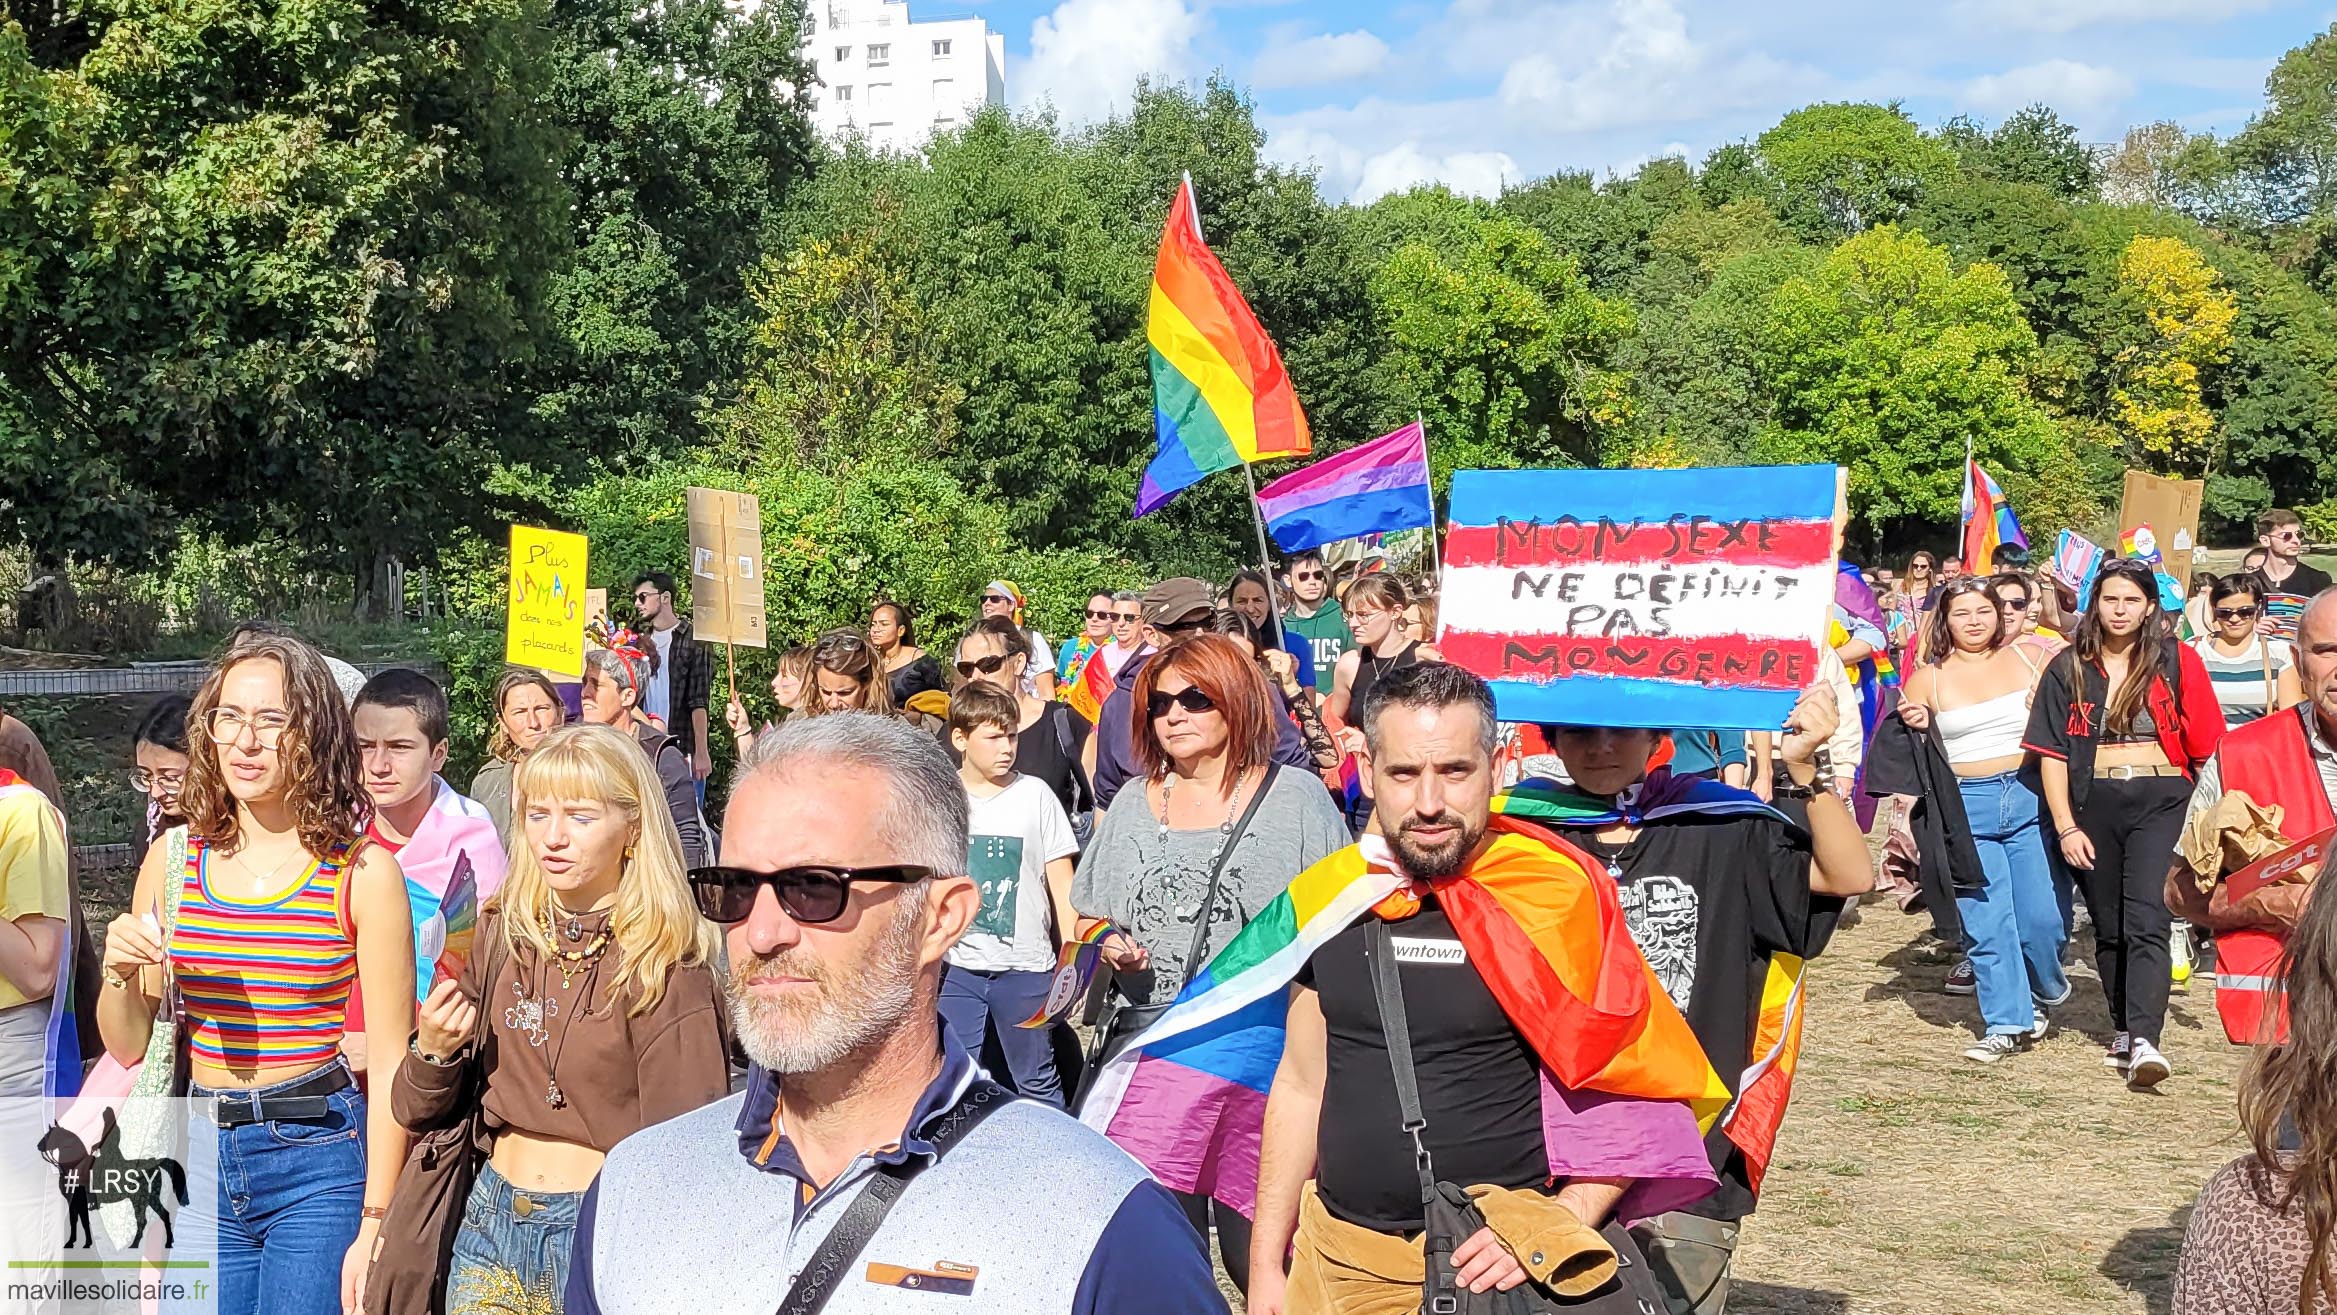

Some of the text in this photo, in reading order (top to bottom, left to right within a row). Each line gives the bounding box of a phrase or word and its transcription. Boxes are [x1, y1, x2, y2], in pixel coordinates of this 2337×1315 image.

[1496, 513, 1783, 560] MON SEXE
[522, 542, 569, 568] Plus
[516, 570, 577, 620] JAMAIS
[1512, 571, 1585, 602] NE
[1567, 604, 1673, 637] PAS
[521, 632, 575, 655] placards
[1308, 638, 1341, 663] ICS
[1504, 642, 1803, 686] MON GENRE
[2260, 844, 2320, 879] cgt
[1395, 944, 1463, 959] wntown
